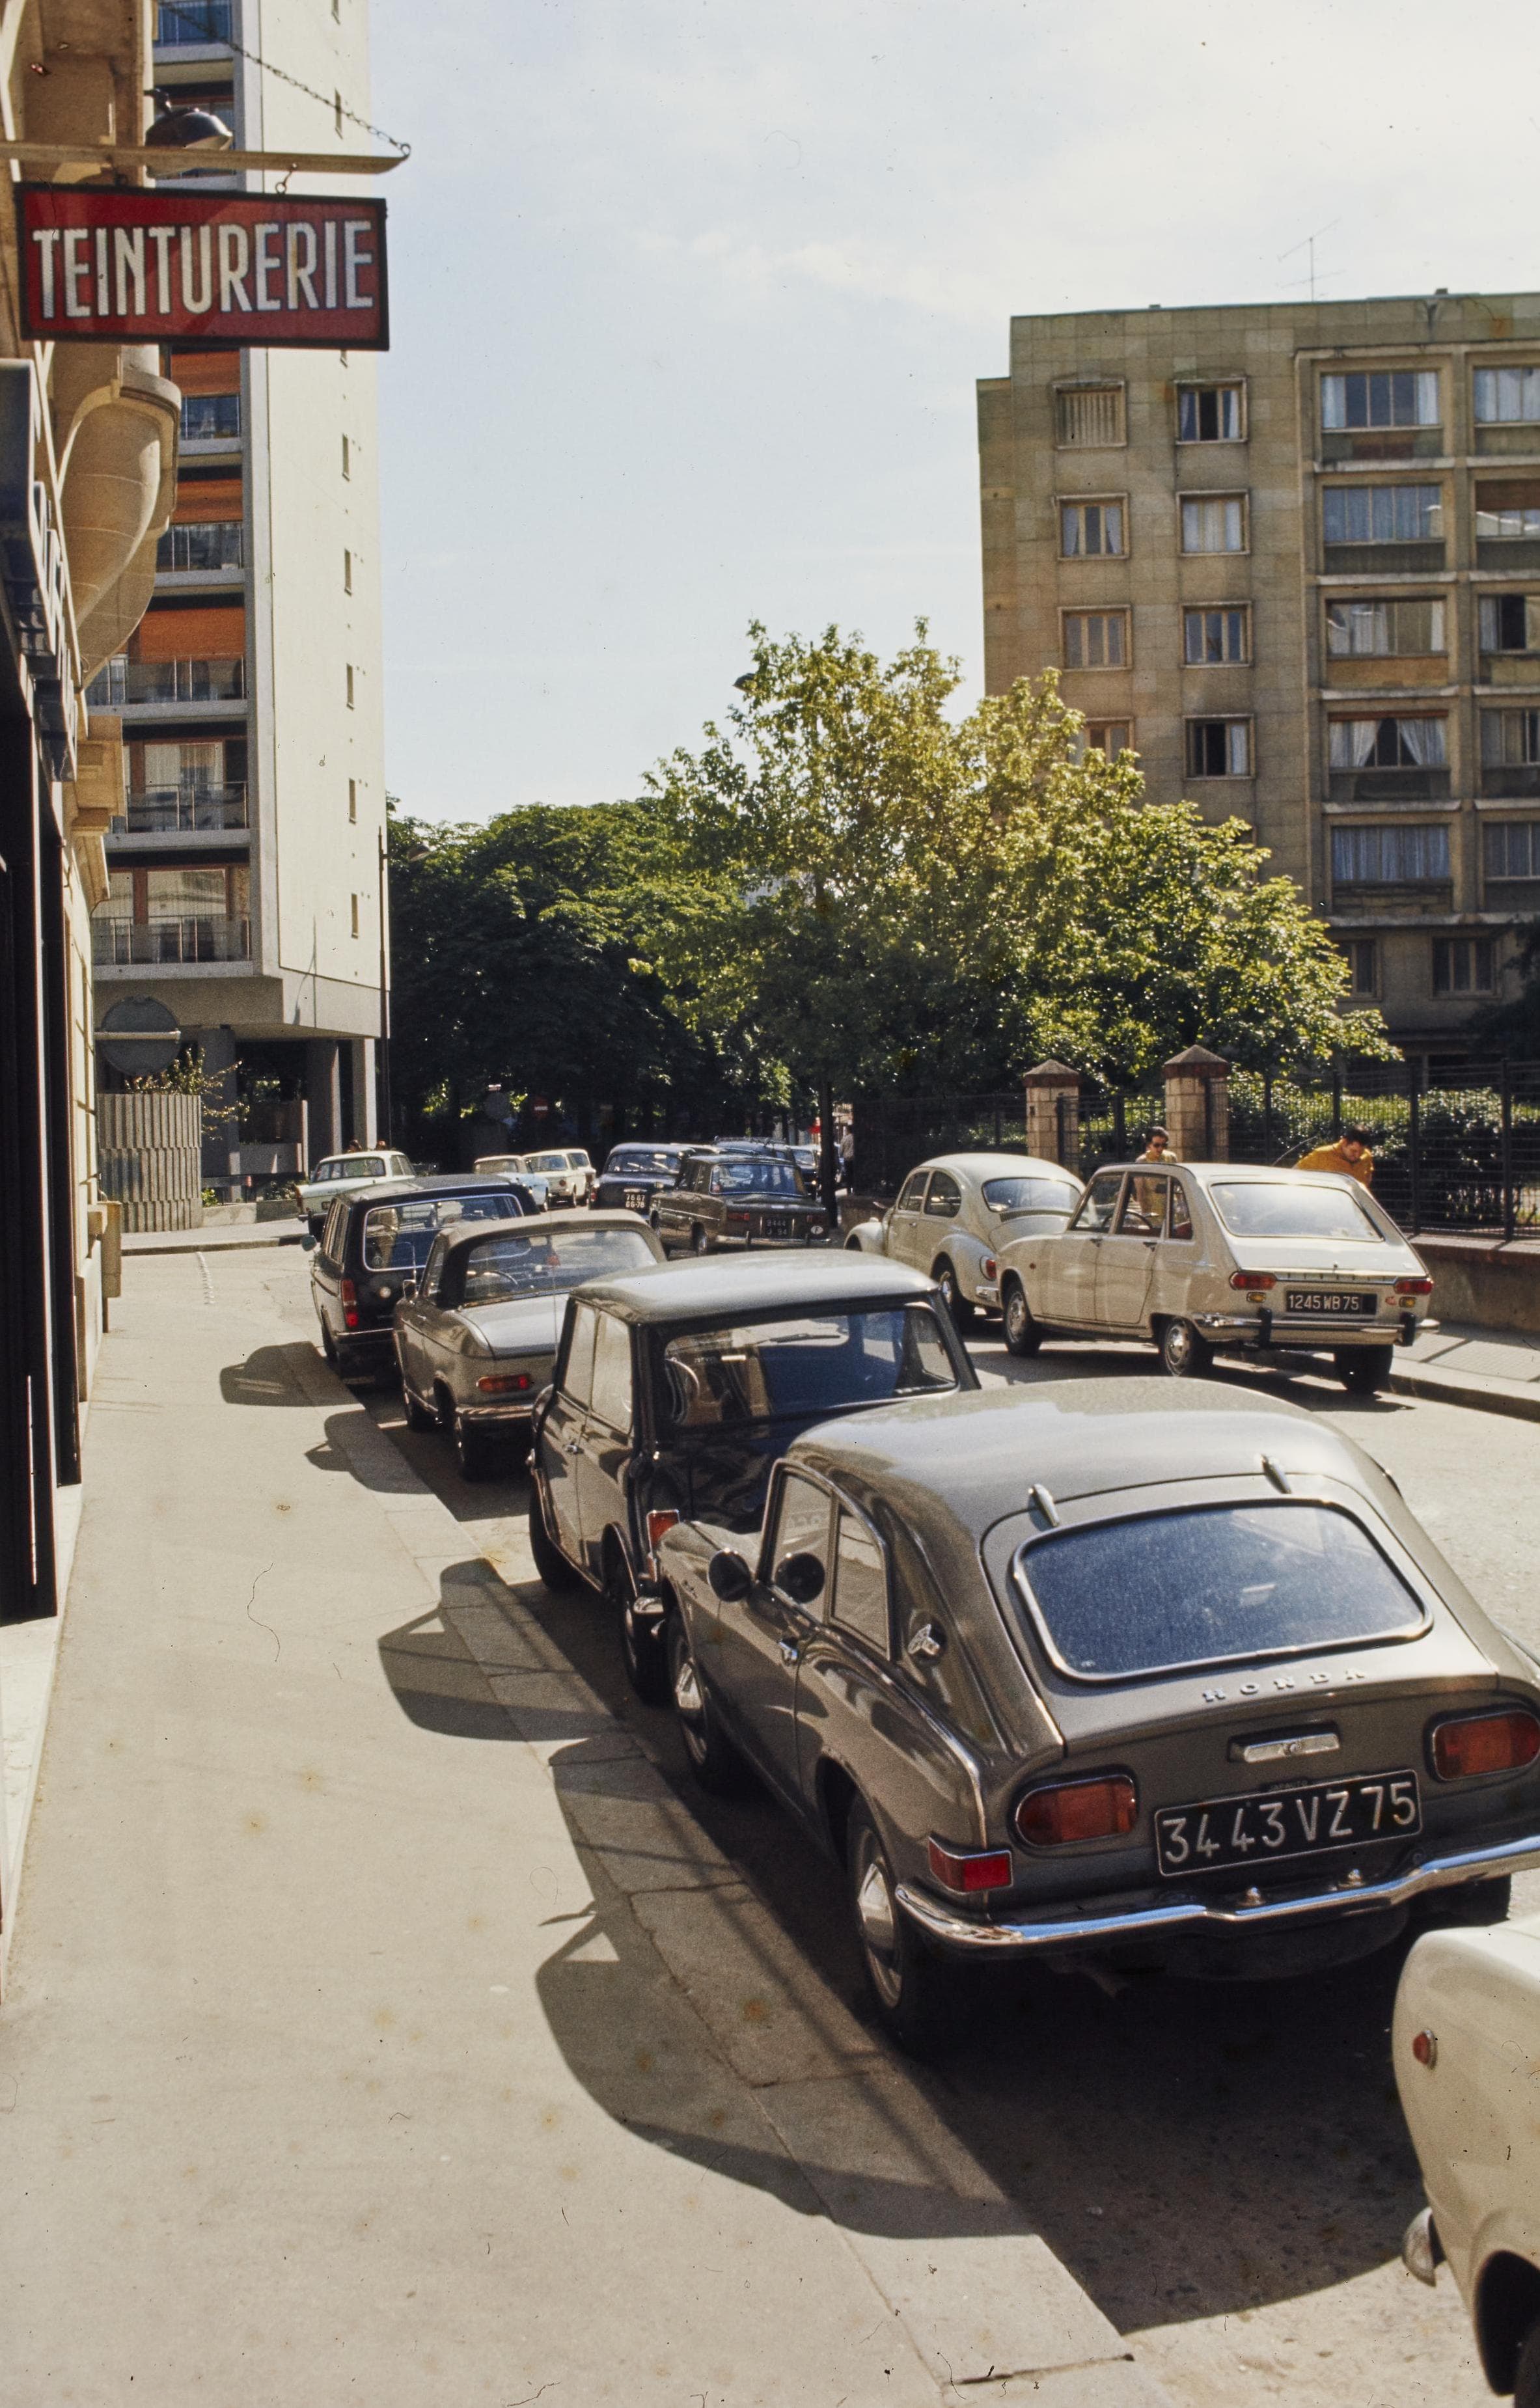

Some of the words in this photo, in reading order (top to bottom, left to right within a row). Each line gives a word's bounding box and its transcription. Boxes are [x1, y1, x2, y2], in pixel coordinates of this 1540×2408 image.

[33, 220, 374, 319] TEINTURERIE
[1289, 1294, 1321, 1309] 1245
[1323, 1296, 1341, 1310] WB
[1343, 1296, 1360, 1311] 75
[1202, 1669, 1366, 1703] HONDA
[1162, 1801, 1287, 1864] 3443
[1296, 1790, 1353, 1842] VZ
[1360, 1781, 1416, 1831] 75
